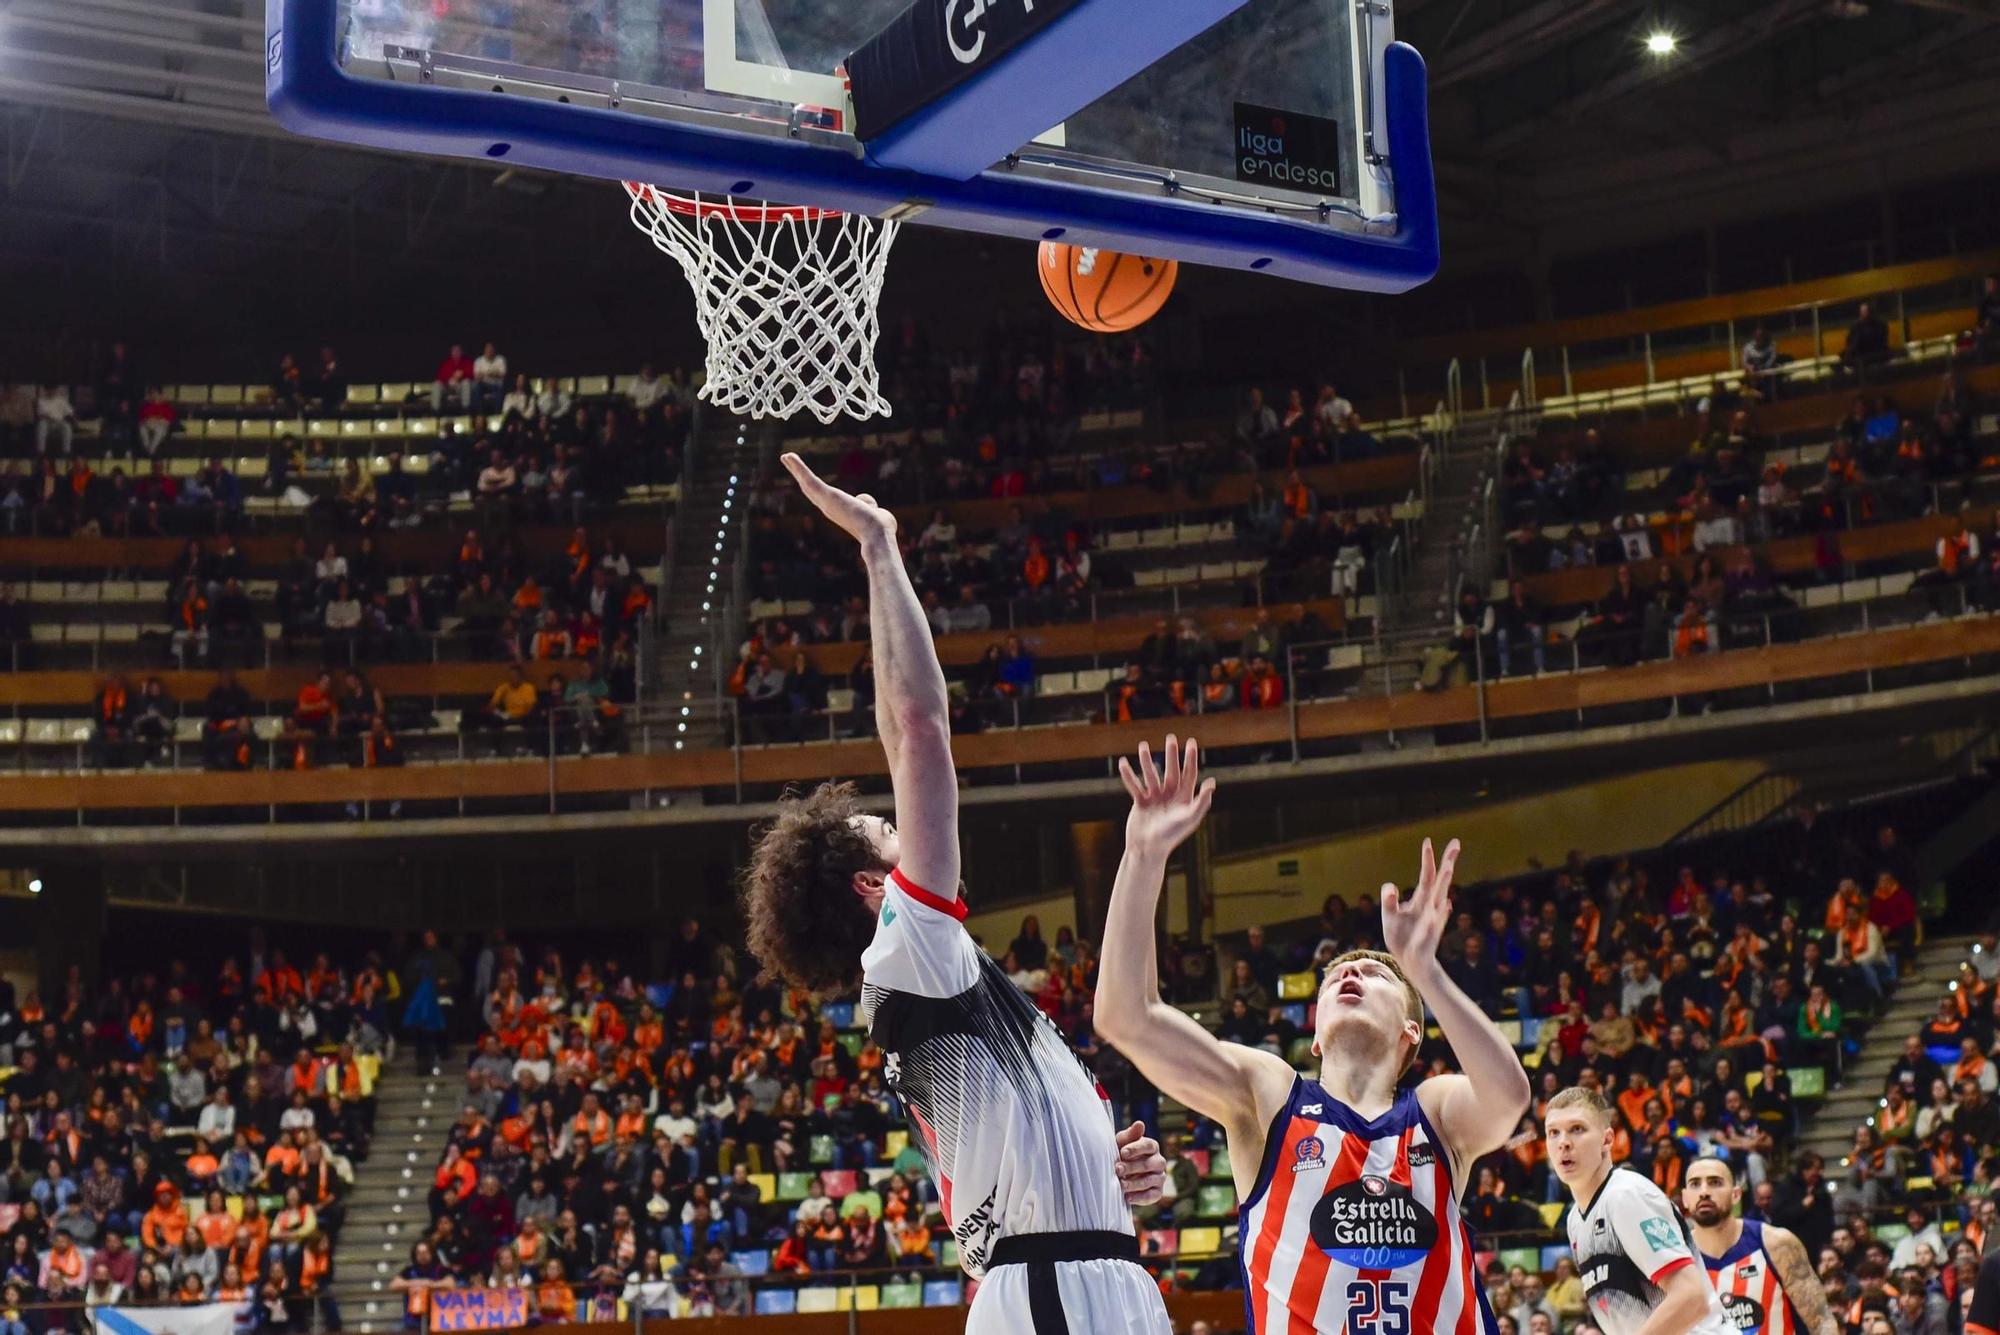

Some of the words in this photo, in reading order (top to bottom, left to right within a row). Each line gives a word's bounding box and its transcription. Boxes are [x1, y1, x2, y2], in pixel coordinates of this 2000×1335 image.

[1241, 127, 1283, 156] liga
[1242, 156, 1335, 189] endesa
[1331, 1197, 1418, 1221] Estrella
[1334, 1220, 1417, 1244] Galicia
[1363, 1245, 1391, 1267] 0,0
[434, 1288, 523, 1309] VAMOS
[1346, 1280, 1410, 1335] 25
[439, 1310, 522, 1329] LEYMA
